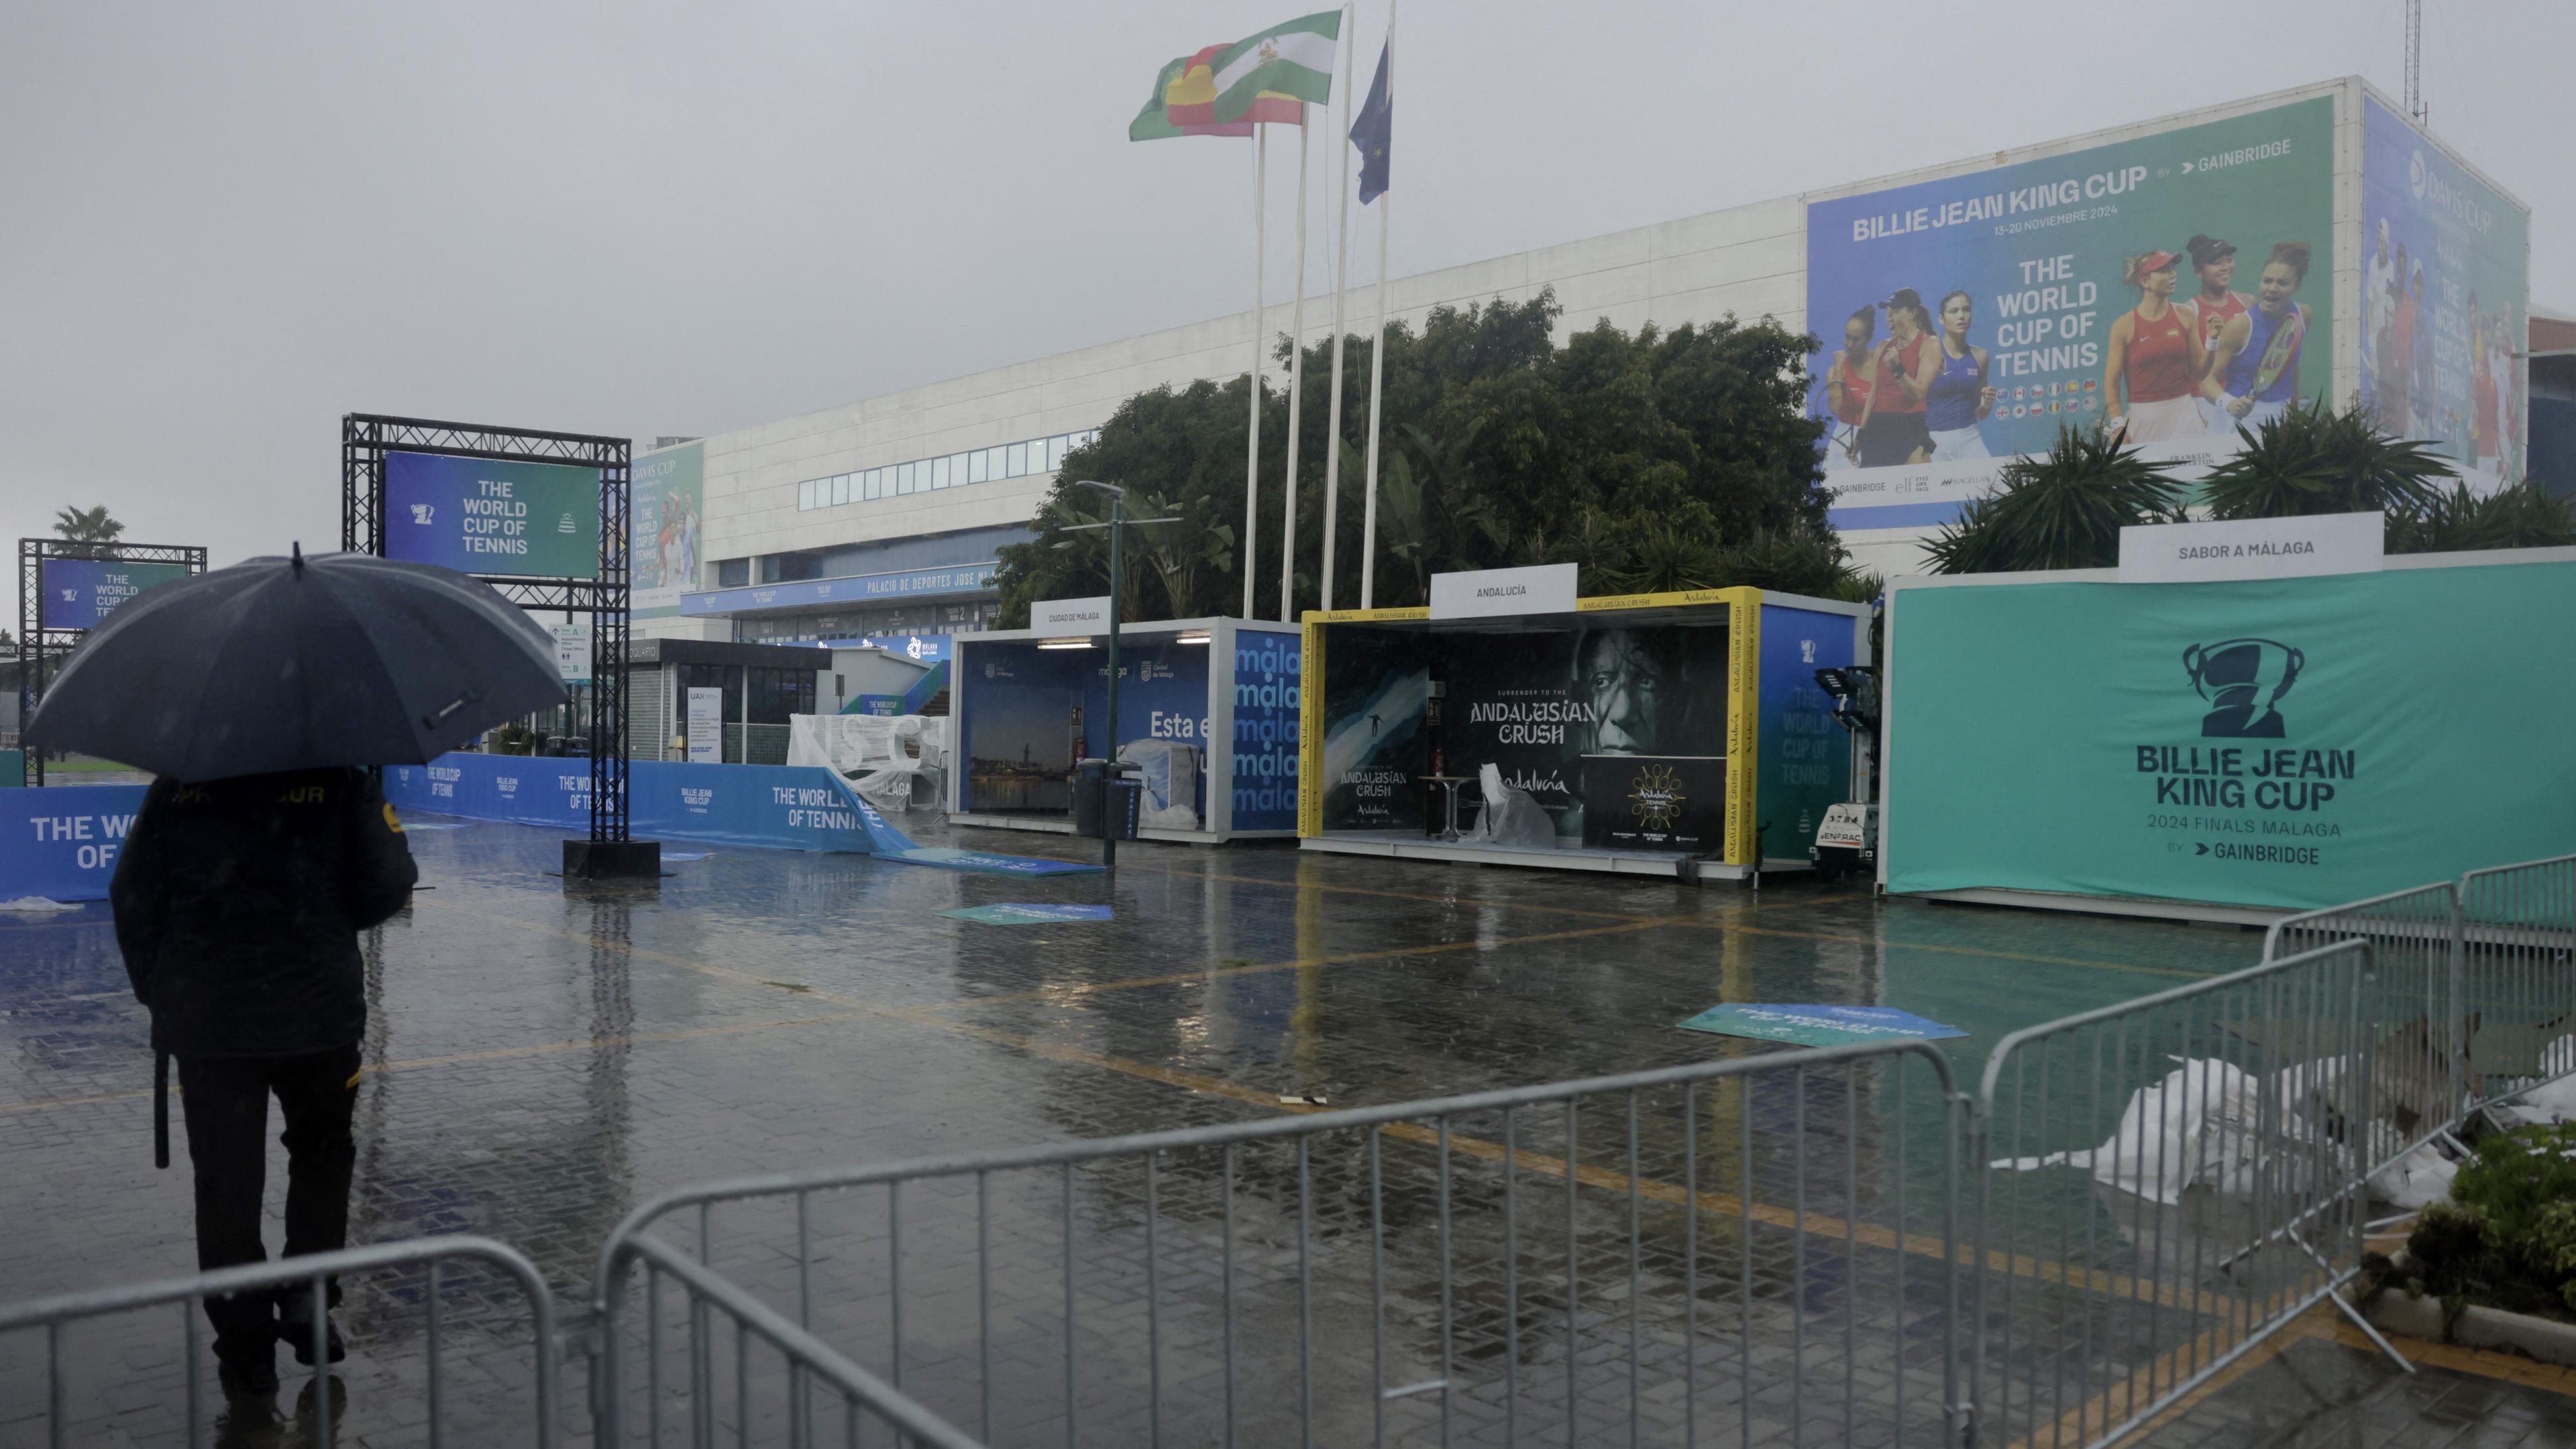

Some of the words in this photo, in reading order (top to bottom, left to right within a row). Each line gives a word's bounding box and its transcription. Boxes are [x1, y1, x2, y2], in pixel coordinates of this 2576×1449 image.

[1854, 208, 1929, 241] BILLIE
[1933, 193, 2002, 228] JEAN
[2010, 178, 2080, 215] KING
[2084, 166, 2147, 199] CUP
[2157, 167, 2171, 177] BY
[2198, 140, 2291, 172] GAINBRIDGE
[2427, 172, 2463, 219] DAVIS
[2465, 200, 2491, 235] CUP
[1994, 222, 2022, 237] 13-20
[2024, 210, 2087, 231] NOVIEMBRE
[2090, 205, 2118, 219] 2024
[2019, 254, 2074, 284] THE
[1997, 282, 2097, 317] WORLD
[2442, 276, 2459, 308] THE
[1998, 318, 2053, 347] CUP
[2059, 311, 2096, 339] OF
[2435, 303, 2465, 340] WORLD
[1995, 342, 2098, 377] TENNIS
[2434, 334, 2453, 364] CUP
[2454, 341, 2465, 369] OF
[2434, 364, 2465, 400] TENNIS
[2169, 451, 2211, 462] FRANKLIN
[631, 464, 655, 482] DAVIS
[657, 460, 676, 475] CUP
[478, 480, 513, 498] THE
[1839, 482, 1886, 493] GAINBRIDGE
[1895, 476, 1913, 493] elf
[463, 498, 527, 517] WORLD
[641, 507, 653, 521] THE
[463, 517, 499, 534] CUP
[503, 520, 527, 536] OF
[636, 521, 657, 535] WORLD
[462, 536, 527, 555] TENNIS
[636, 535, 647, 549] CUP
[648, 534, 657, 546] OF
[2179, 544, 2229, 560] SABOR
[2233, 544, 2244, 558] A
[2247, 539, 2315, 557] MÁLAGA
[635, 548, 657, 561] TENNIS
[105, 574, 129, 584] THE
[867, 579, 896, 594] PALACIO
[900, 578, 909, 591] DE
[912, 574, 951, 590] DEPORTES
[954, 572, 974, 586] JOSE
[96, 585, 139, 596] WORLD
[97, 596, 120, 606] CUP
[1477, 583, 1526, 598] ANDALUCÍA
[959, 606, 965, 621] 2
[1049, 613, 1068, 623] CIUDAD
[1069, 613, 1076, 621] DE
[1076, 610, 1099, 621] MÁLAGA
[1159, 671, 1174, 679] Málaga
[690, 692, 705, 700] UAX
[1793, 686, 1821, 709] THE
[1151, 711, 1193, 738] Esta
[1499, 723, 1564, 745] CRUSH
[1784, 712, 1831, 735] WORLD
[1783, 738, 1810, 759] CUP
[1812, 740, 1829, 759] OF
[2137, 745, 2243, 776] BILLIE
[2251, 749, 2355, 779] JEAN
[427, 767, 436, 780] THE
[436, 767, 450, 781] WORLD
[450, 768, 461, 782] CUP
[559, 775, 575, 790] THE
[1505, 769, 1571, 795] ndalucía
[1782, 764, 1831, 785] TENNIS
[432, 782, 438, 796] OF
[439, 783, 453, 797] TENNIS
[682, 788, 698, 797] BILLIE
[698, 788, 712, 798] JEAN
[772, 787, 796, 805] THE
[873, 782, 910, 796] ALAGA
[1356, 784, 1391, 797] CRUSH
[2157, 776, 2245, 808] KING
[2255, 780, 2334, 812] CUP
[570, 794, 581, 809] OF
[684, 796, 698, 804] KING
[698, 797, 710, 805] CUP
[789, 809, 804, 826] OF
[806, 810, 863, 830] TENNI
[1127, 792, 1135, 835] GRACIAS
[30, 816, 93, 841] THE
[2147, 814, 2189, 829] 2024
[2194, 816, 2255, 833] FINALS
[2262, 820, 2341, 838] MALAGA
[77, 844, 117, 869] OF
[2167, 842, 2184, 853] BY
[2214, 843, 2320, 865] GAINBRIDGE
